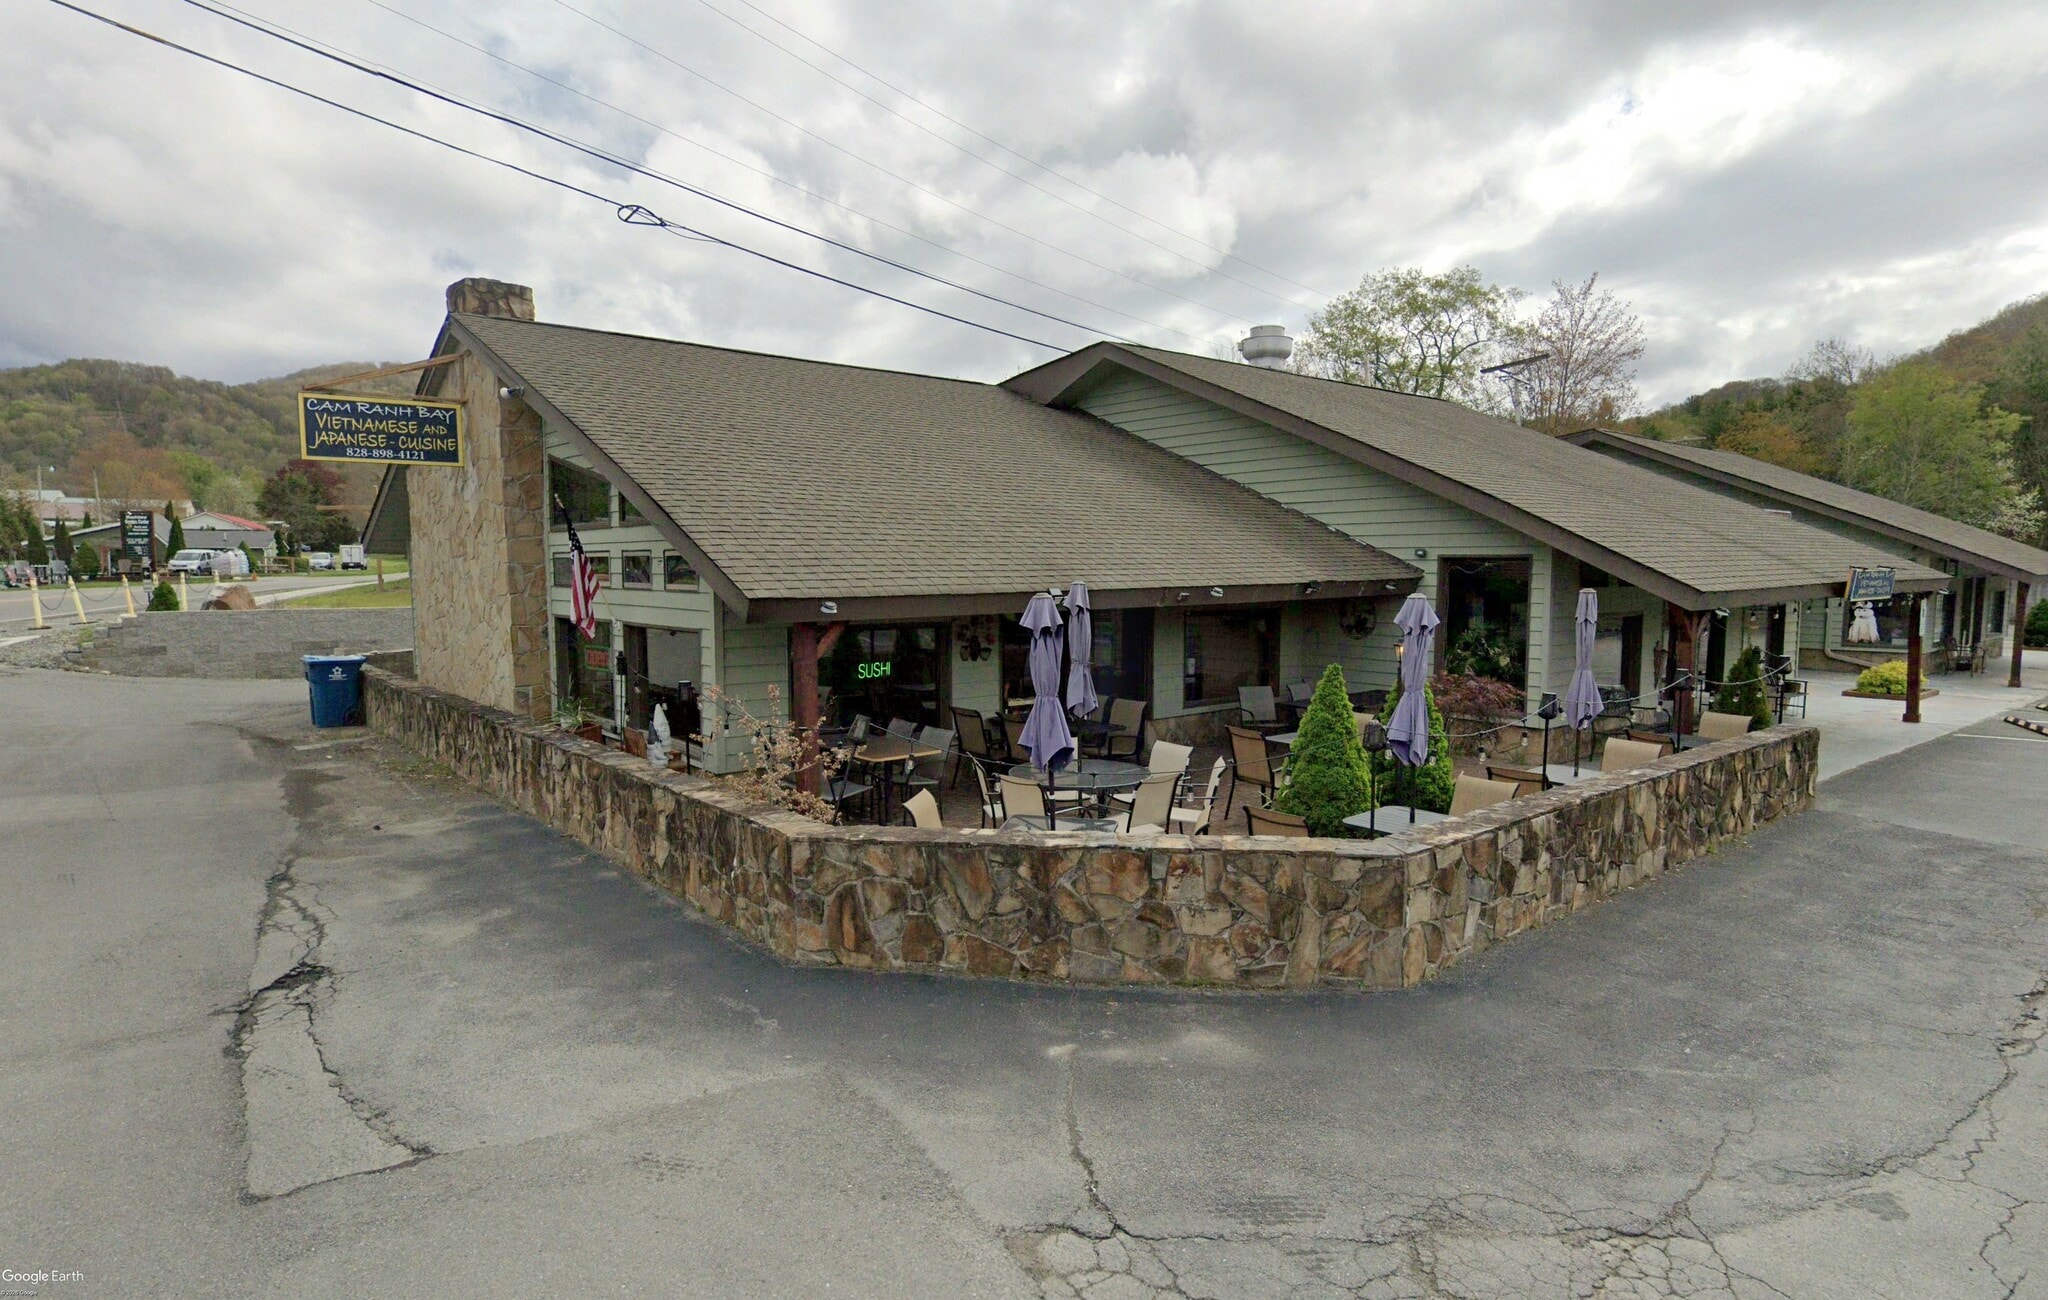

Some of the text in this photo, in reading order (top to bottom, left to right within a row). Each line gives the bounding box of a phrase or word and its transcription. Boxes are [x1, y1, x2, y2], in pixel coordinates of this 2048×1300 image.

[307, 398, 455, 424] CAM RANH BAY
[315, 412, 448, 435] VIETNAMESE AND
[308, 431, 387, 449] JAPANESE
[398, 435, 456, 451] CUISINE
[346, 447, 425, 460] 828-898-4121
[858, 661, 891, 679] SUSHI
